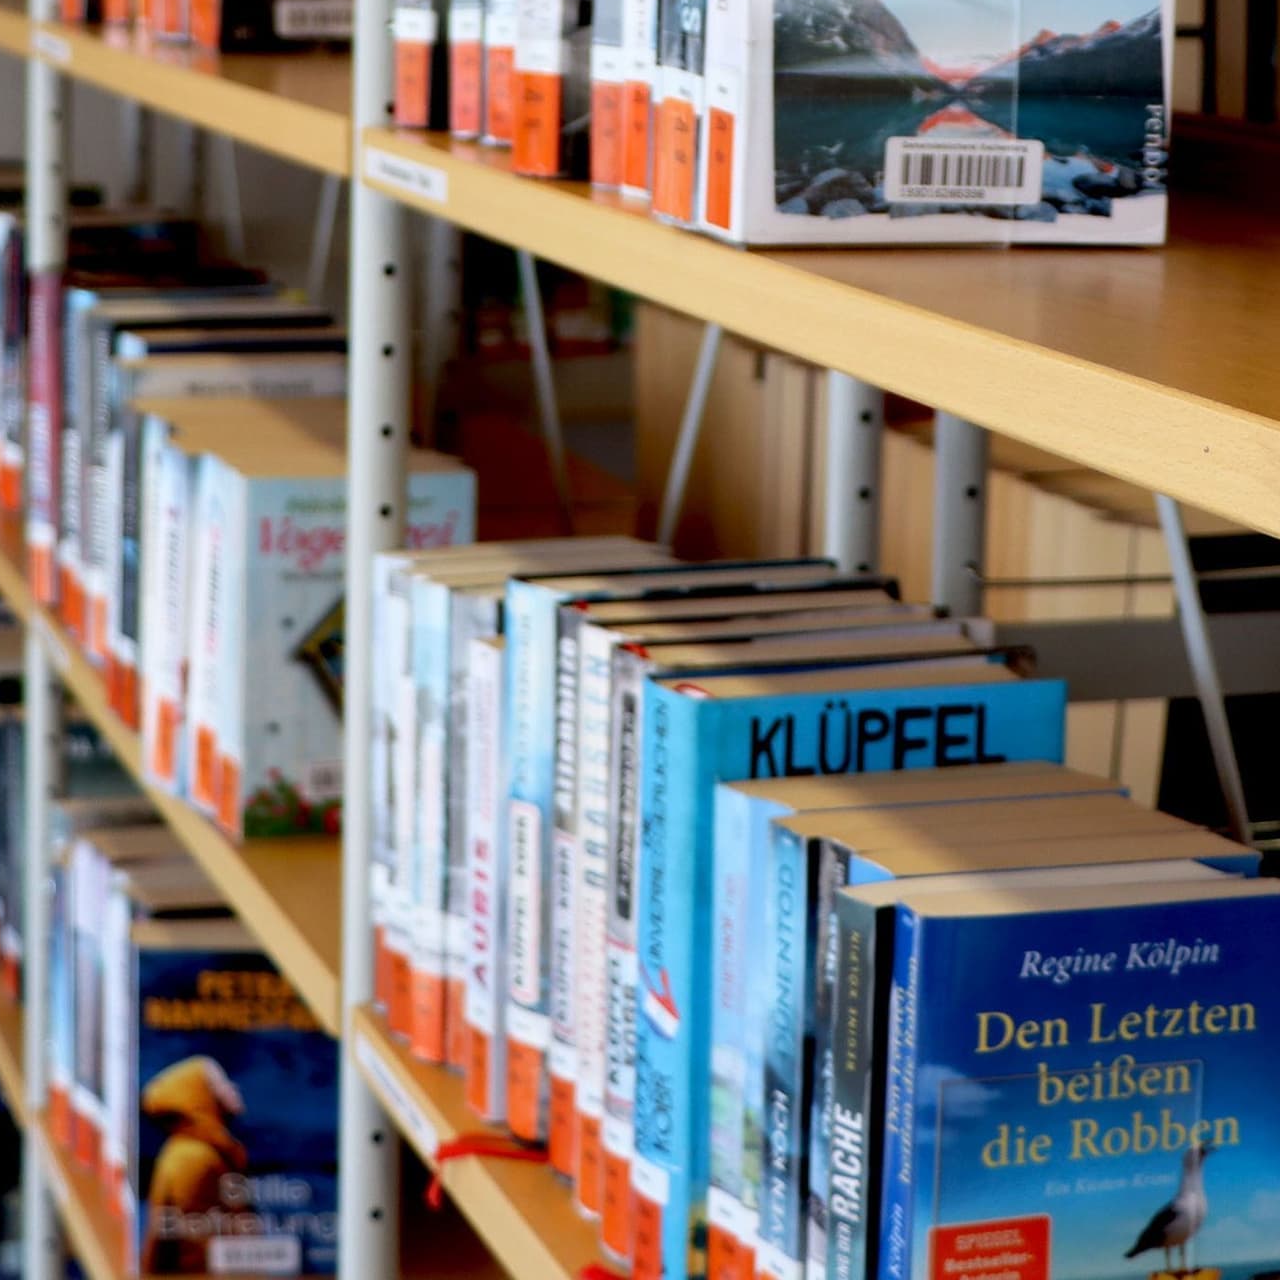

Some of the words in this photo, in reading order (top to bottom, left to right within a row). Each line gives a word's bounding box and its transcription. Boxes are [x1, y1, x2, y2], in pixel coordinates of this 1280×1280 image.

[750, 701, 1007, 779] KLÜPFEL
[773, 863, 795, 1055] DÜNENTOD
[848, 930, 861, 999] KÖLPIN
[1020, 947, 1118, 985] Regine
[1125, 937, 1221, 975] Kölpin
[845, 1006, 858, 1072] REGINE
[974, 1011, 1069, 1054] Den
[1088, 1000, 1257, 1045] Letzten
[1037, 1054, 1192, 1106] beißen
[772, 1089, 789, 1171] KOCH
[831, 1102, 863, 1222] RACHE
[981, 1123, 1053, 1169] die
[1068, 1108, 1241, 1161] Robben
[888, 1201, 905, 1278] Kölpin
